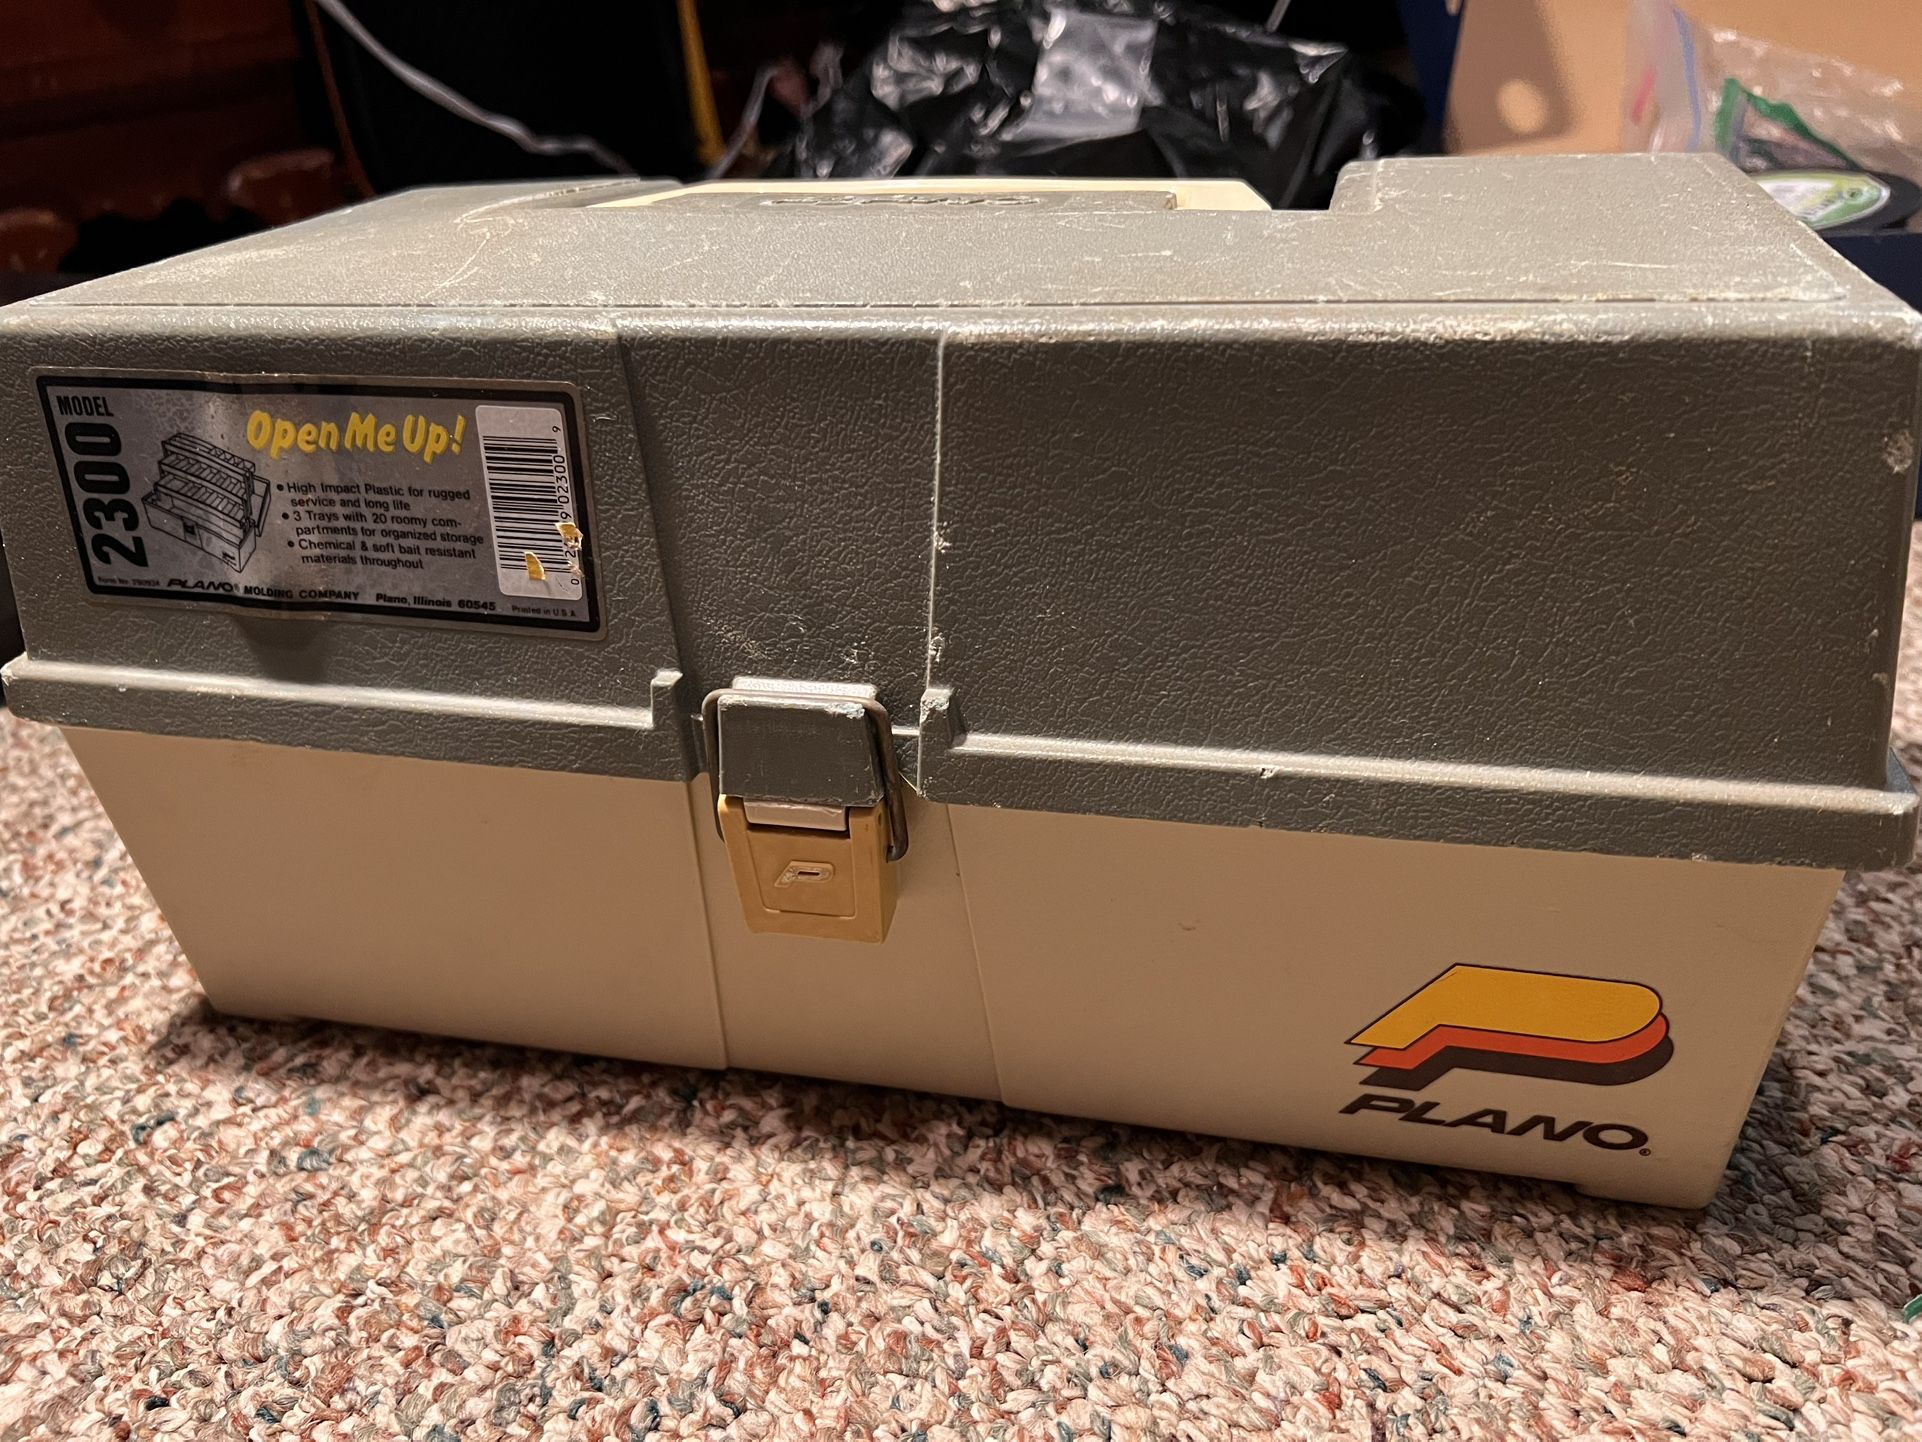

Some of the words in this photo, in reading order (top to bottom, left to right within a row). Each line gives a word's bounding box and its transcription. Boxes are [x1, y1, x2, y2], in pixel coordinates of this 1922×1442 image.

[56, 396, 114, 417] MODEL
[247, 410, 340, 461] Open
[345, 411, 397, 453] Me
[402, 414, 467, 465] Up!
[551, 425, 562, 433] 9
[553, 454, 570, 504] 02300
[64, 422, 148, 567] 2300
[287, 482, 316, 495] High
[320, 483, 361, 495] Impact
[364, 483, 404, 496] Plastic
[408, 486, 424, 497] for
[428, 489, 470, 501] rugged
[290, 497, 336, 508] service
[339, 498, 361, 508] and
[364, 498, 390, 511] long
[392, 500, 411, 511] life
[292, 510, 302, 522] 3
[305, 510, 339, 523] Trays
[342, 512, 367, 523] with
[371, 512, 388, 524] 20
[390, 515, 427, 528] roomy
[431, 518, 462, 528] com-
[295, 524, 358, 537] partments
[360, 526, 376, 537] for
[380, 528, 437, 541] organized
[440, 532, 484, 546] storage
[298, 538, 356, 550] Chemical
[360, 541, 369, 552] &
[372, 542, 395, 554] soft
[398, 543, 422, 556] bait
[425, 546, 477, 559] resistant
[301, 553, 358, 565] materials
[360, 555, 425, 570] throughout
[244, 585, 294, 599] MOLDING
[298, 589, 360, 601] COMPANY
[375, 593, 411, 606] Plano,
[413, 595, 453, 608] Illinois
[457, 599, 497, 611] 60545
[511, 604, 542, 615] Printed
[543, 607, 551, 616] in
